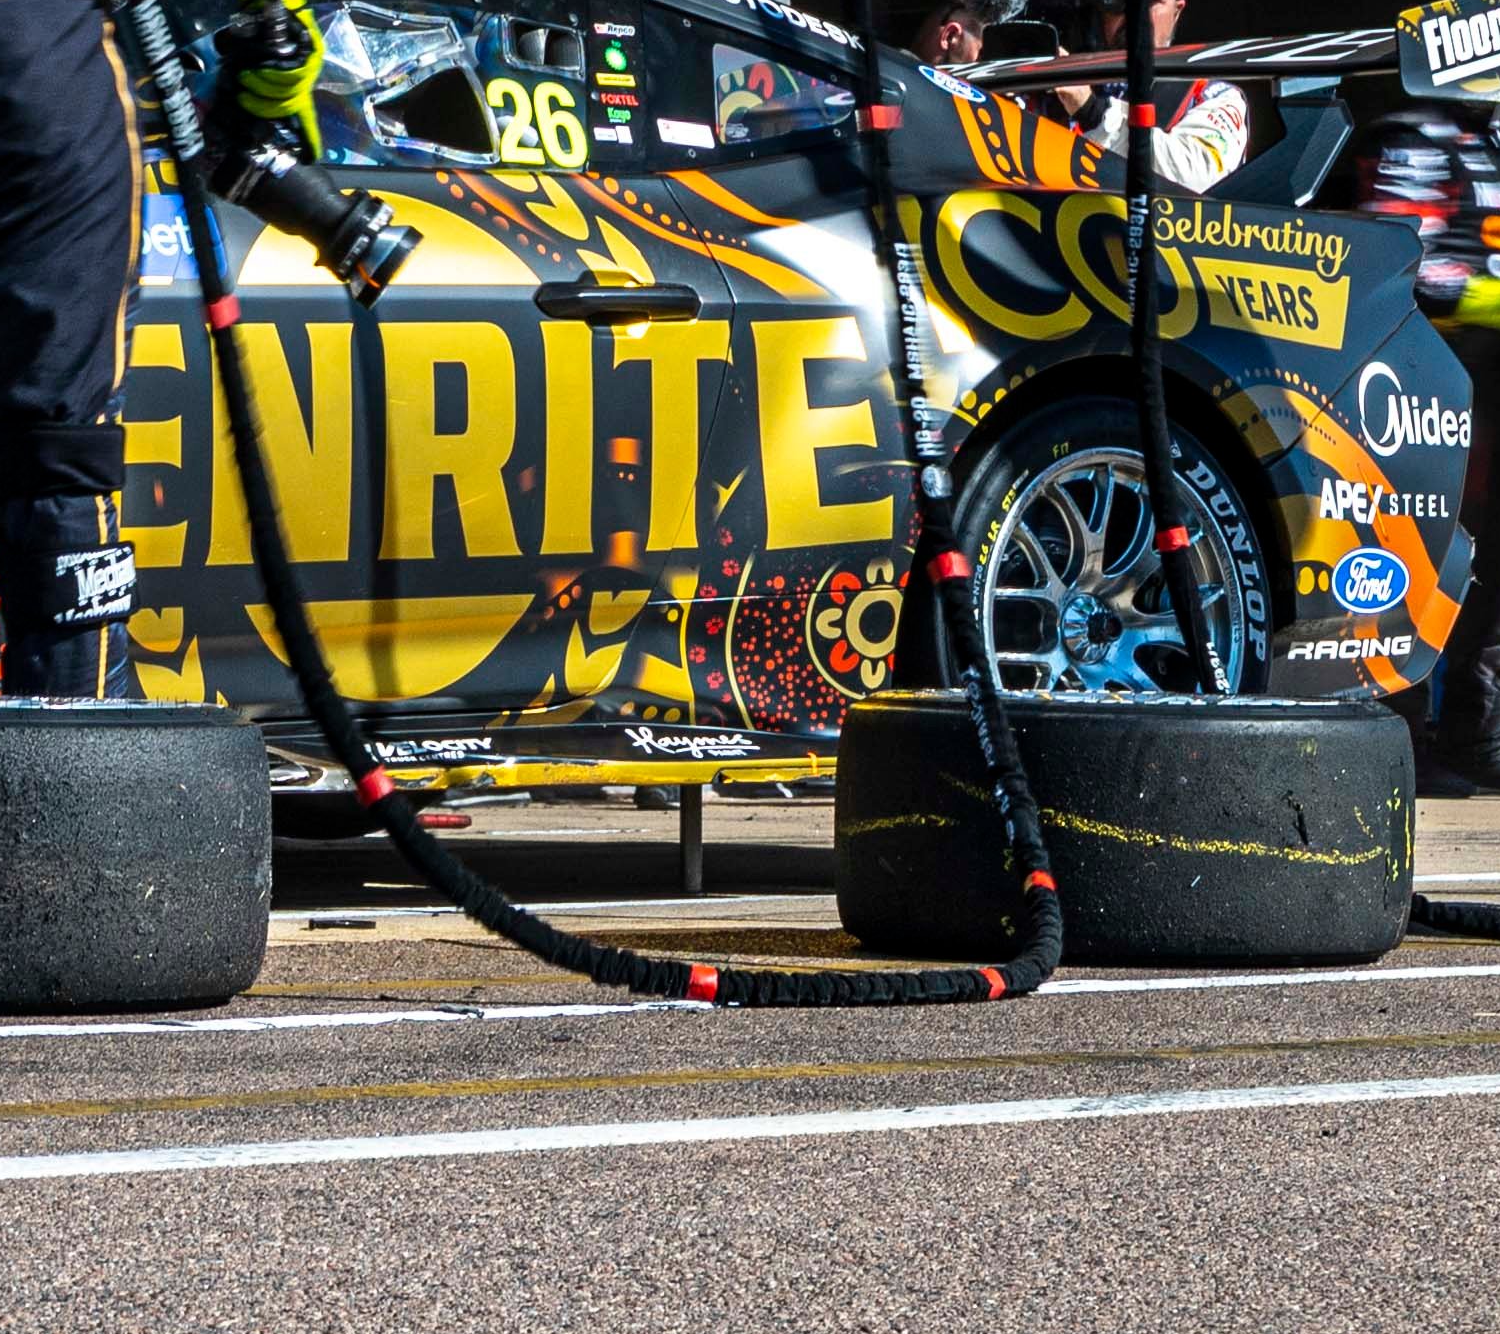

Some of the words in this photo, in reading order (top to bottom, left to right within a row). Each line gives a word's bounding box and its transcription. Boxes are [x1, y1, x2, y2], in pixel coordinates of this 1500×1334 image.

[600, 92, 640, 107] FOXTEL
[932, 71, 976, 99] Ford
[486, 76, 590, 169] 26
[1151, 196, 1352, 283] Celebrating
[1215, 272, 1321, 334] YEARS
[1359, 360, 1472, 457] Midea
[1319, 476, 1383, 525] APEX
[1388, 493, 1450, 519] STEEL
[1185, 459, 1270, 663] DUNLOP
[1344, 557, 1403, 605] Ford
[1287, 635, 1413, 661] RACING
[377, 736, 494, 757] VELOCITY
[624, 725, 754, 759] Haymes
